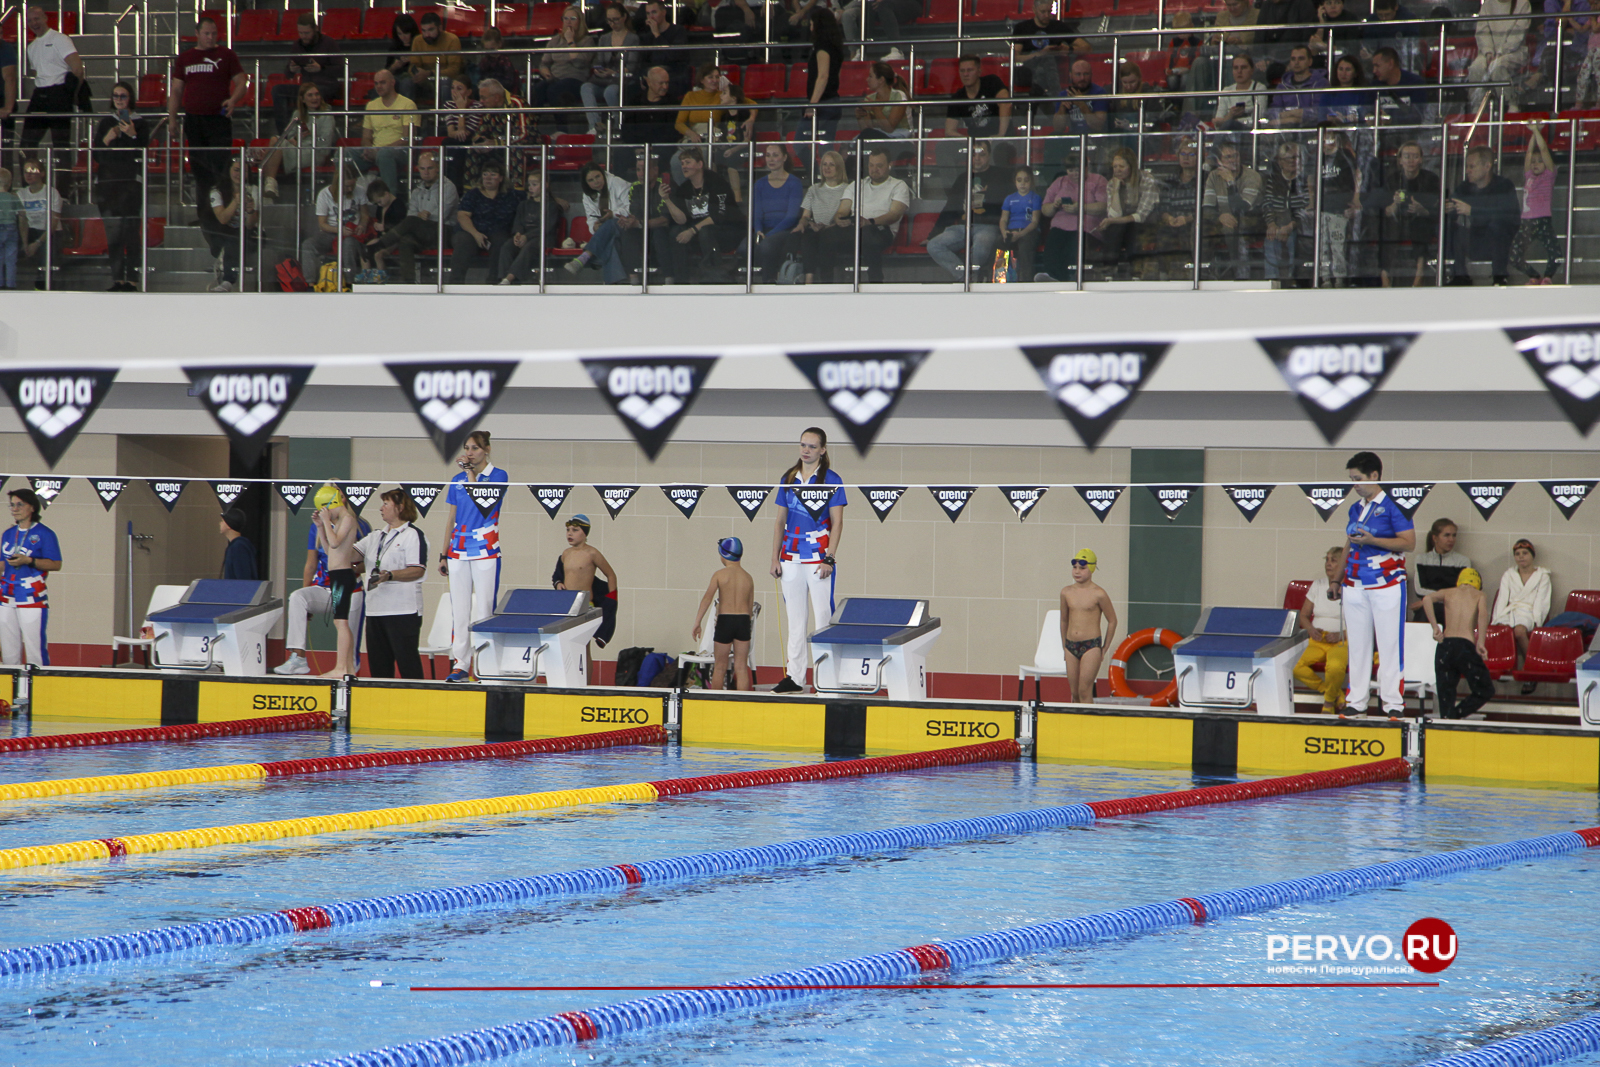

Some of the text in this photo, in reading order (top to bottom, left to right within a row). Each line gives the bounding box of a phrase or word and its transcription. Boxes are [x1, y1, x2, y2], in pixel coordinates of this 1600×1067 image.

[185, 63, 214, 75] PUMA
[1287, 344, 1385, 375] arena
[1048, 352, 1141, 384] arena
[608, 364, 692, 397] arena
[818, 359, 900, 391] arena
[209, 374, 287, 404] arena
[414, 369, 491, 400] arena
[19, 377, 92, 406] arena
[97, 481, 122, 491] arena
[155, 482, 181, 492] arena
[217, 484, 243, 493] arena
[281, 485, 307, 495] arena
[346, 486, 371, 496] arena
[410, 487, 437, 497] arena
[472, 487, 500, 497] arena
[1391, 486, 1423, 498] arena
[1470, 485, 1503, 497] arena
[1552, 484, 1586, 496] arena
[538, 488, 564, 498] arena
[604, 488, 630, 499] arena
[671, 489, 699, 499] arena
[736, 489, 763, 500] arena
[801, 490, 829, 500] arena
[870, 489, 898, 500] arena
[938, 489, 967, 500] arena
[1010, 489, 1039, 500] arena
[1086, 489, 1115, 500] arena
[1158, 489, 1187, 499] arena
[1234, 488, 1265, 499] arena
[1311, 487, 1343, 498] arena
[201, 636, 210, 653] 3
[256, 643, 262, 664] 3
[522, 646, 532, 663] 4
[861, 657, 871, 676] 5
[1226, 671, 1236, 690] 6
[253, 694, 317, 712] SEIKO
[580, 706, 649, 725] SEIKO
[926, 720, 1001, 739] SEIKO
[1304, 736, 1386, 757] SEIKO
